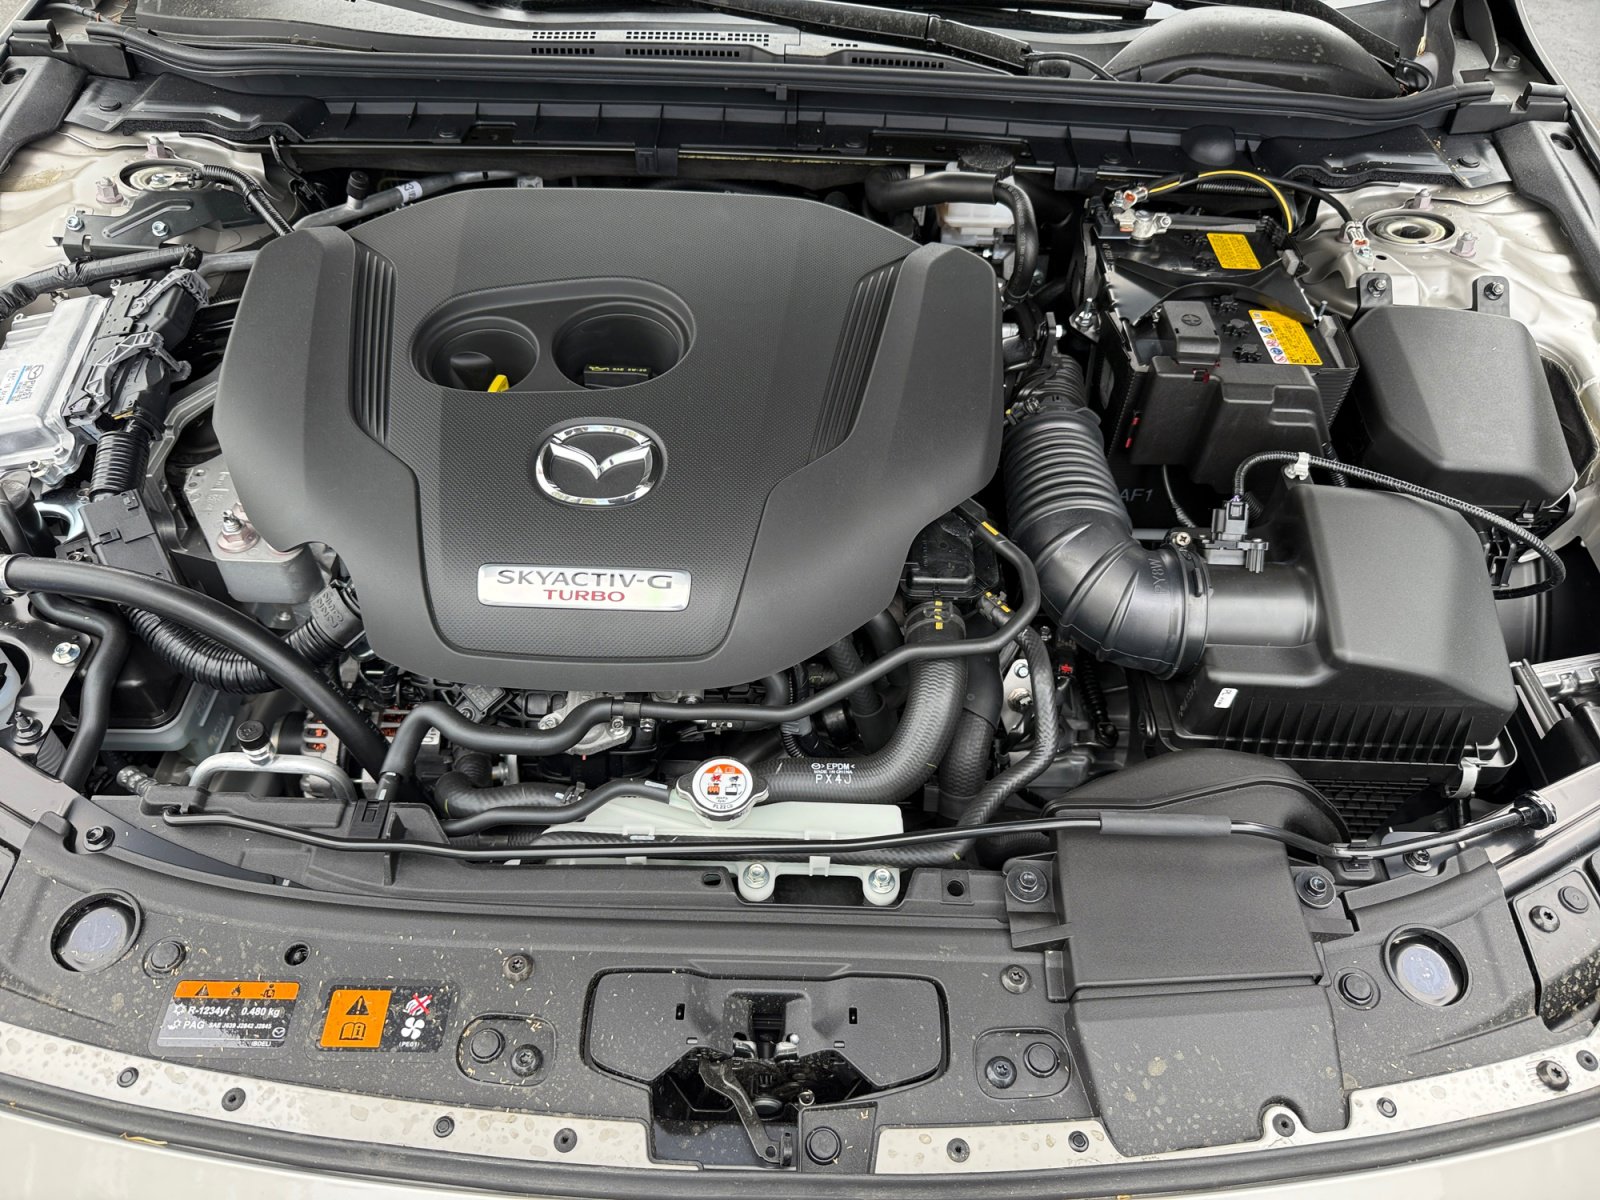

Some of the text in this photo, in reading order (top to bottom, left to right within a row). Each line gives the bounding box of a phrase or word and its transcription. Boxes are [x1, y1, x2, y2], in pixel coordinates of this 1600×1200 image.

[497, 569, 673, 589] SKYACTIV-G
[543, 589, 626, 603] TURBO
[187, 1005, 280, 1018] R-1234yf 0.480 kg
[182, 1020, 205, 1030] PAG
